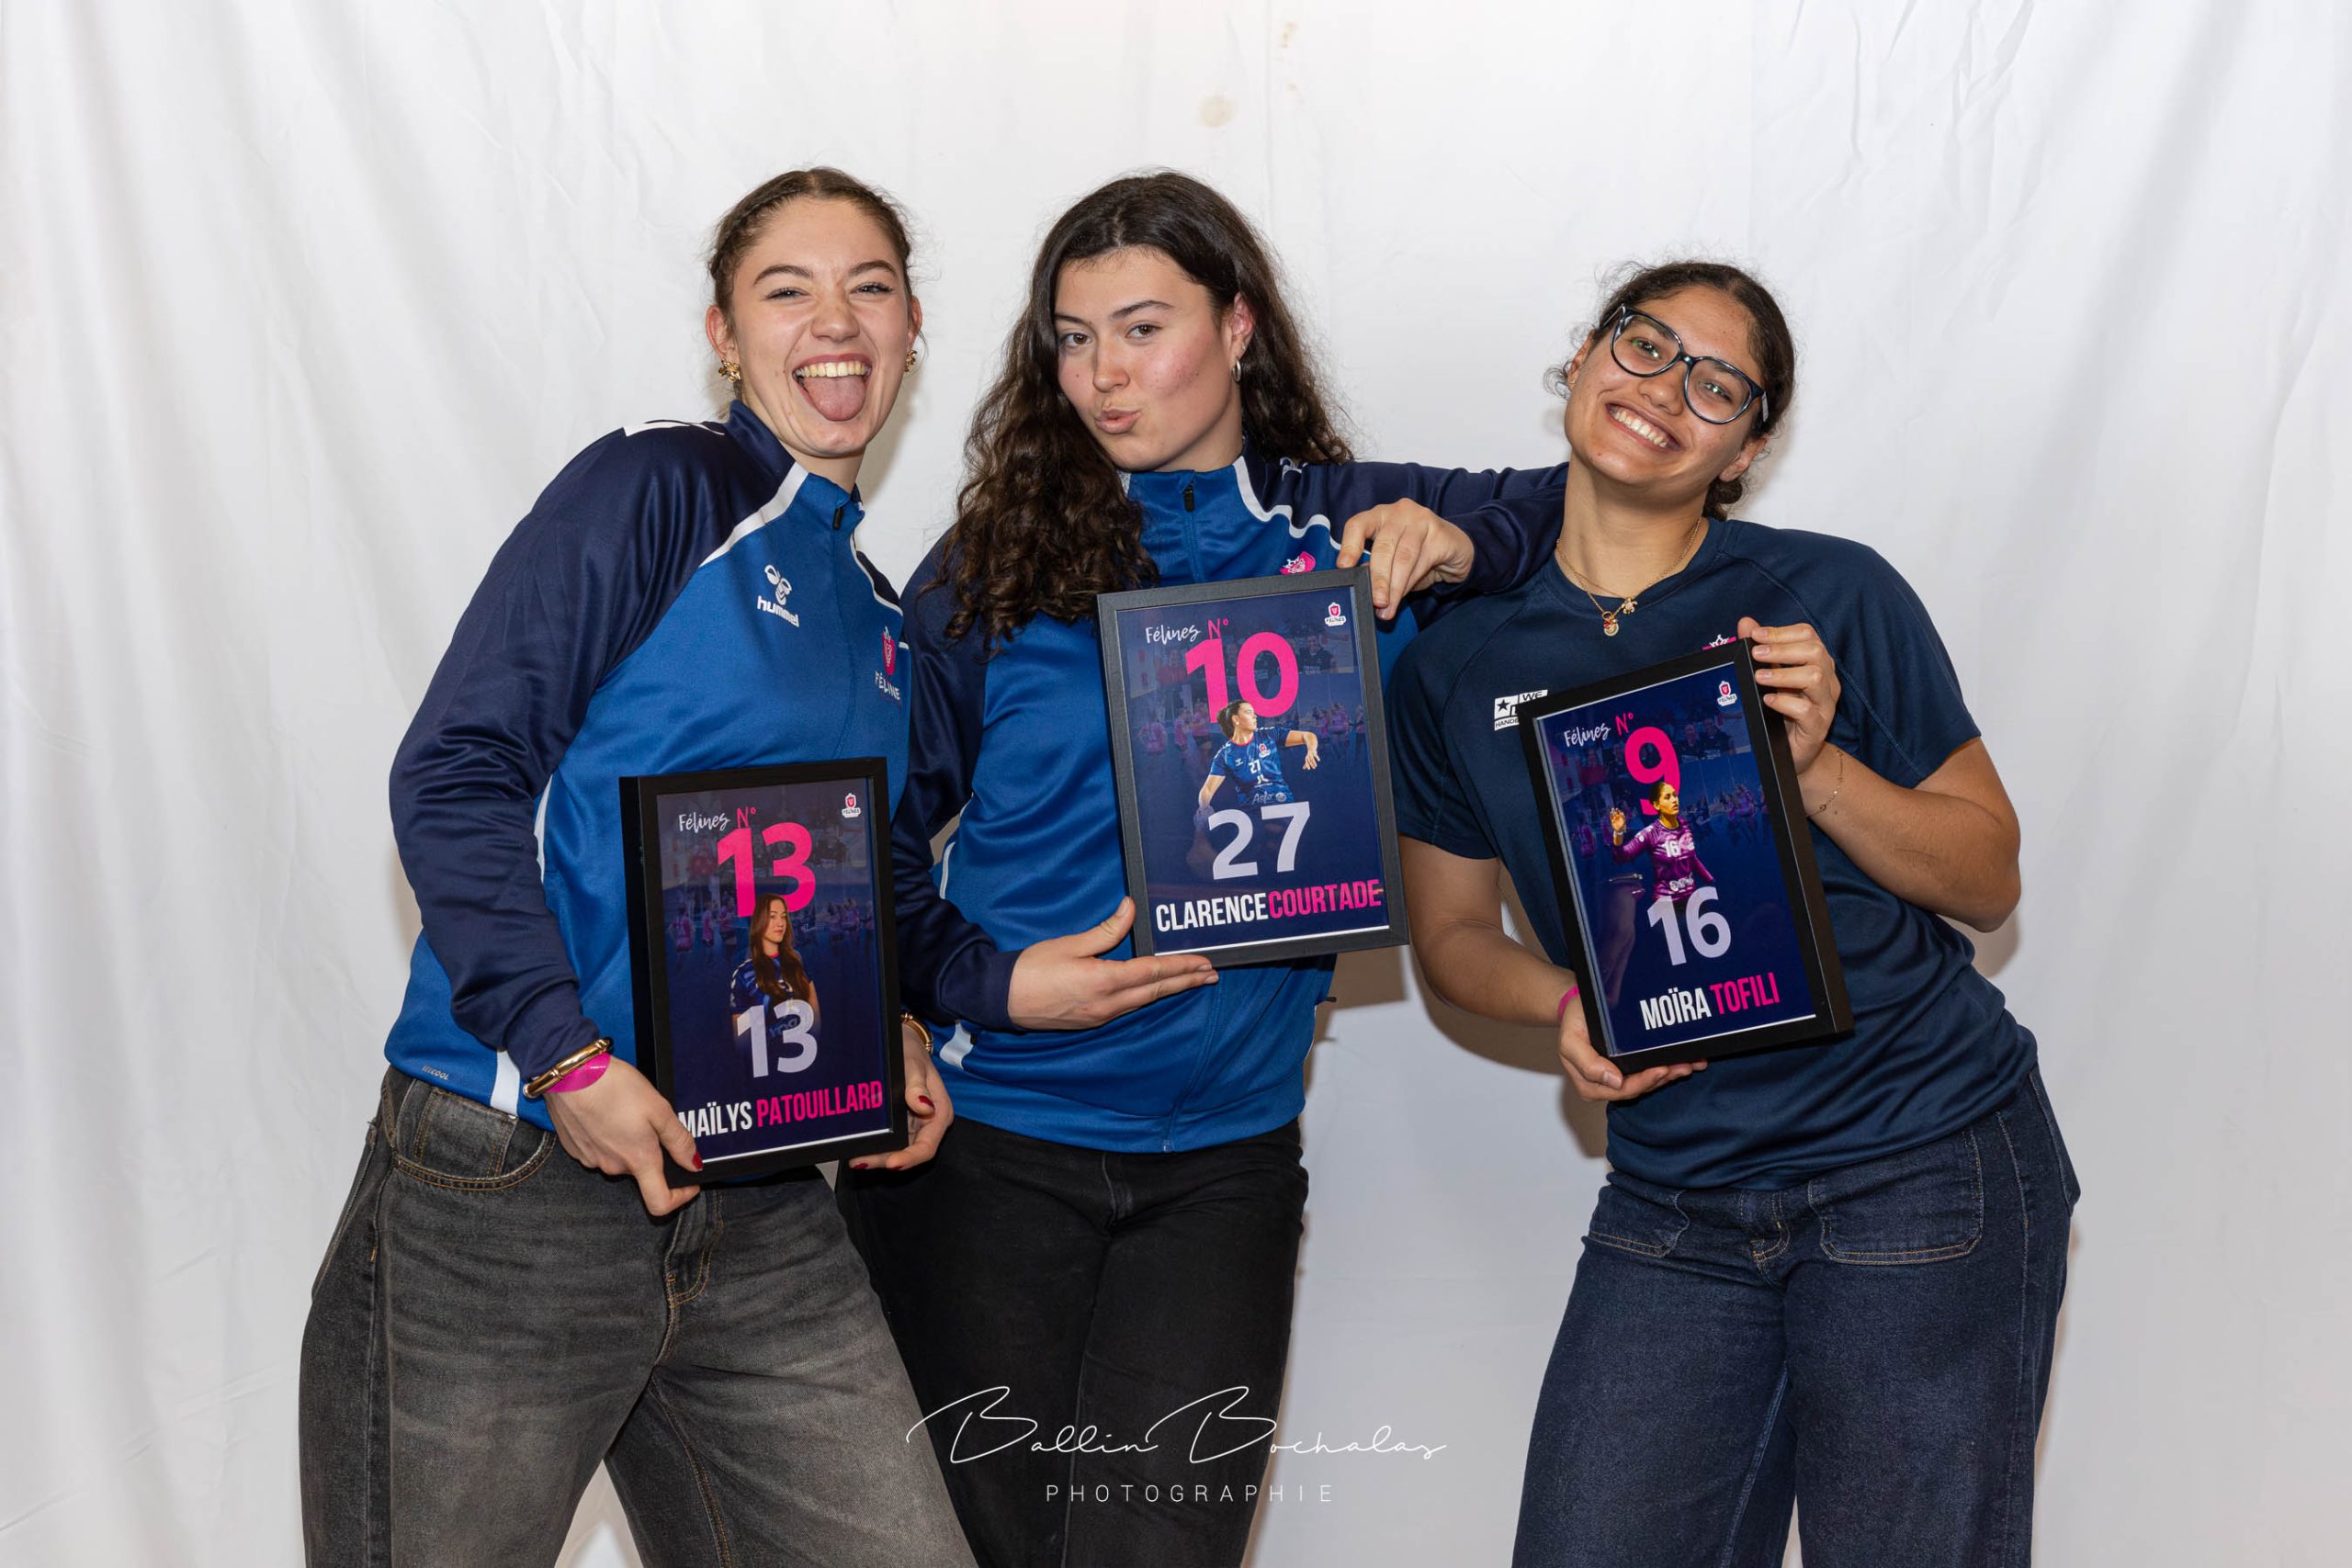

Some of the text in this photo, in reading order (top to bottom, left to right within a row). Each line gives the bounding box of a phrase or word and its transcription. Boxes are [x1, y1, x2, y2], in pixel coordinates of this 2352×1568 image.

[757, 594, 799, 627] hummel
[1145, 625, 1201, 645] Félines
[1185, 631, 1299, 724] 10
[1564, 723, 1611, 748] Félines
[1249, 759, 1261, 774] 27
[1624, 726, 1680, 816] 9
[678, 811, 731, 834] Félines
[1207, 801, 1310, 880] 27
[1661, 839, 1682, 858] 16
[717, 822, 816, 919] 13
[1156, 879, 1381, 932] CLARENCE COURTADE
[1647, 886, 1732, 966] 16
[1639, 972, 1781, 1031] MOÏRA TOFILI
[736, 999, 819, 1078] 13
[678, 1080, 883, 1138] MAÏLYS PATOUILLARD
